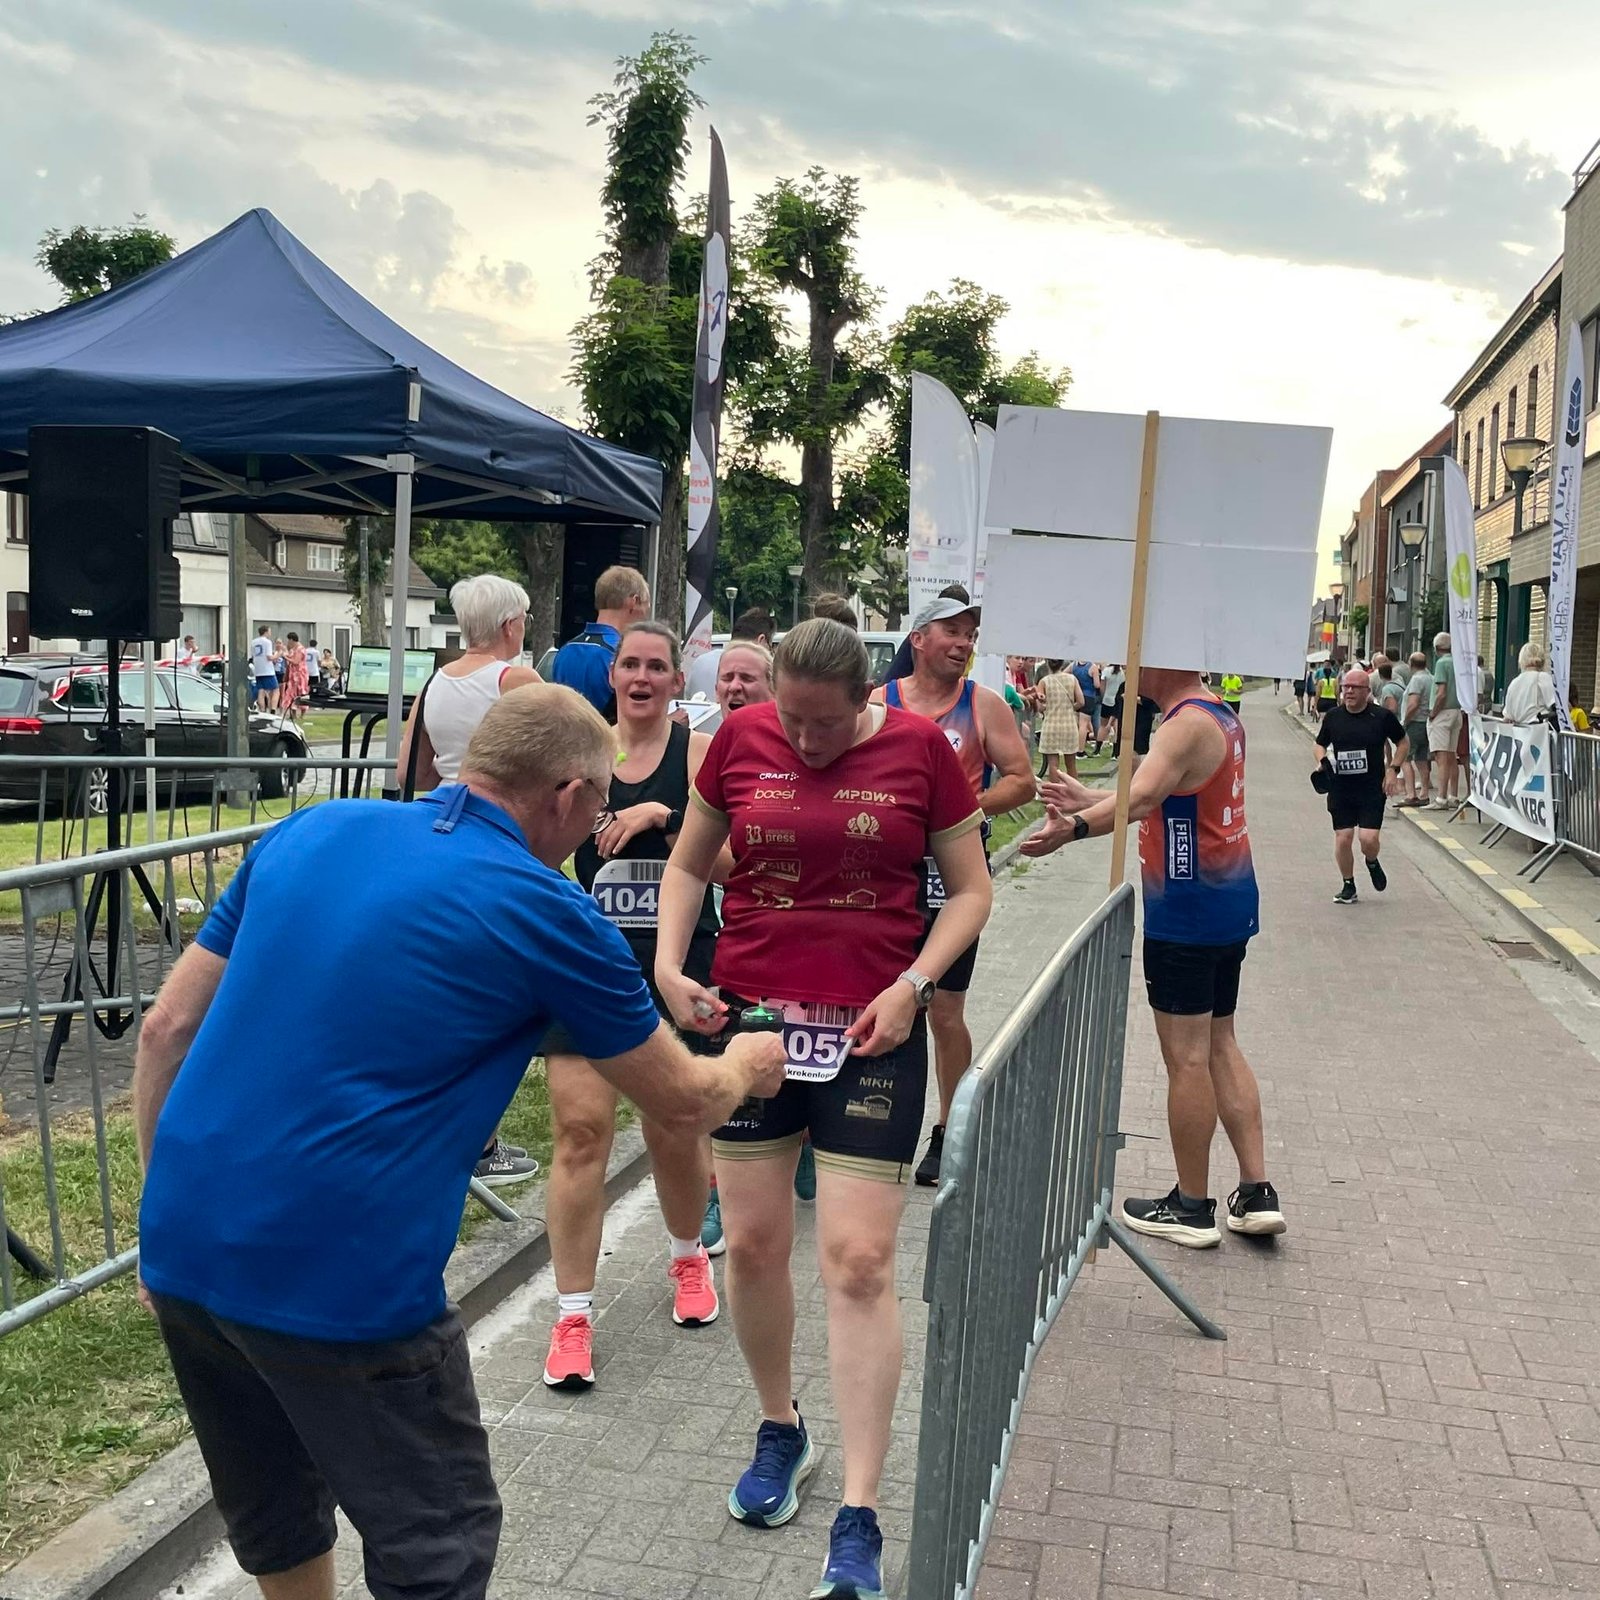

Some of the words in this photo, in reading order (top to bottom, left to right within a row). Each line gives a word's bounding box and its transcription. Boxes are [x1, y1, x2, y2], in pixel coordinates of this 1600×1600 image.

[1340, 760, 1364, 770] 1119
[759, 772, 790, 780] CRAFT
[765, 834, 796, 844] press
[1175, 823, 1189, 874] FIESIEK
[598, 887, 658, 913] 104
[788, 1030, 852, 1064] 05
[860, 1076, 894, 1089] MKH
